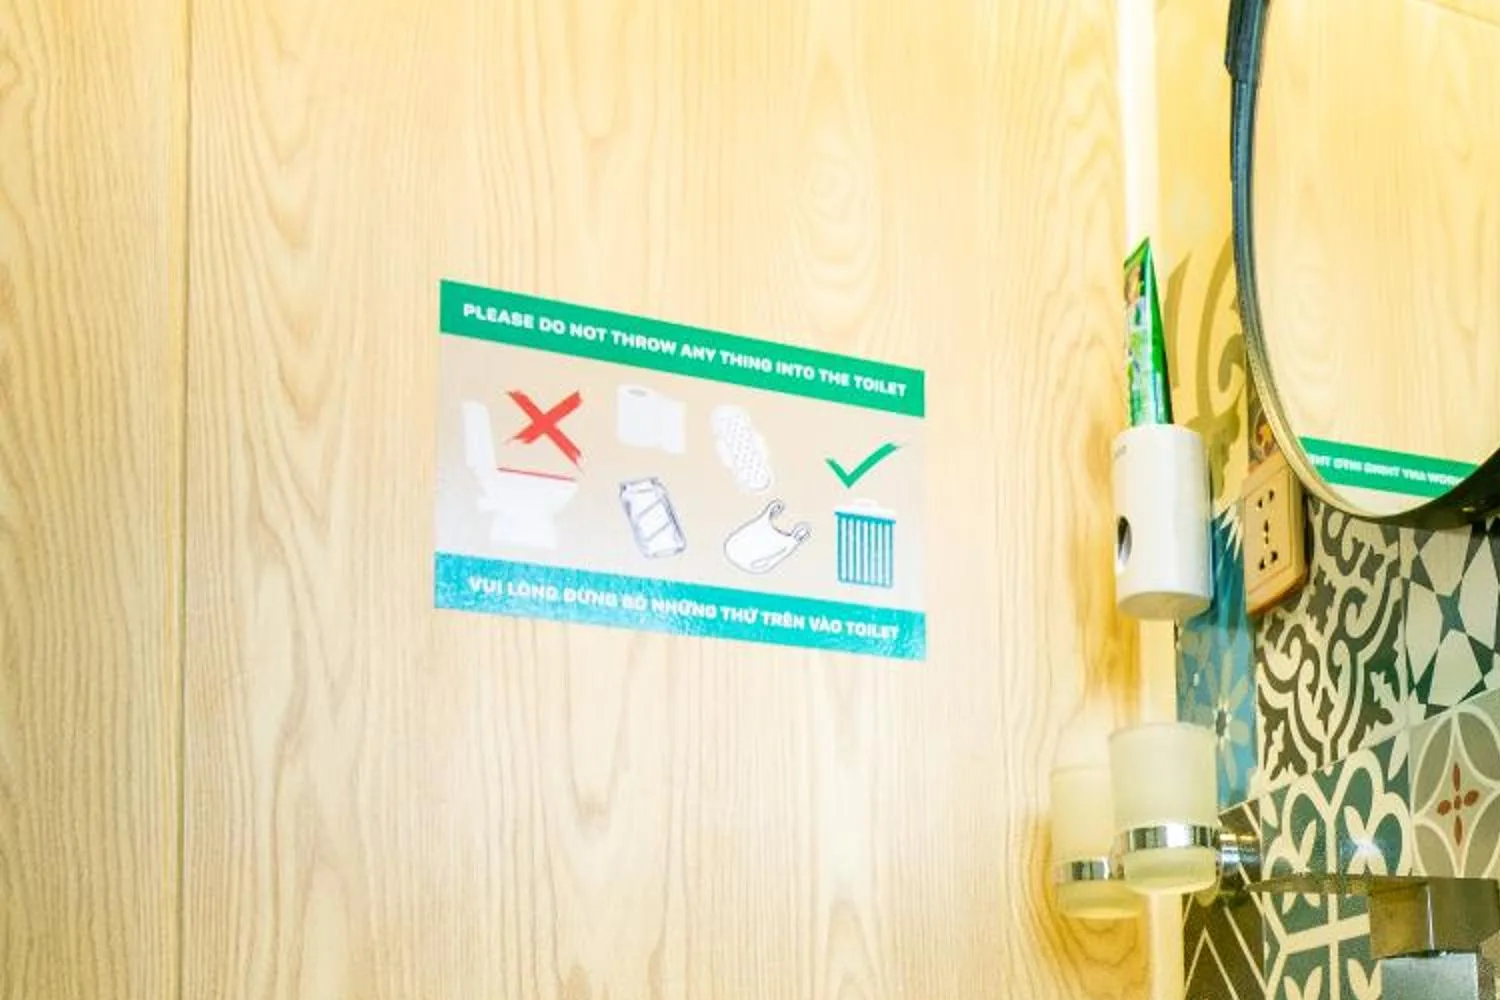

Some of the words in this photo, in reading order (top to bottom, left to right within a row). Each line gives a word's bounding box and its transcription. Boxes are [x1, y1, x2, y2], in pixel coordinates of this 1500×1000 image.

[463, 303, 534, 329] PLEASE
[539, 317, 566, 334] DO
[570, 323, 607, 342] NOT
[611, 330, 677, 356] THROW
[680, 343, 717, 362] ANY
[720, 350, 773, 373] THING
[776, 361, 815, 380] INTO
[819, 368, 850, 387] THE
[854, 375, 907, 398] TOILET
[468, 576, 500, 594] VUI
[761, 610, 804, 629] TRÊN
[846, 621, 900, 641] TOILET
